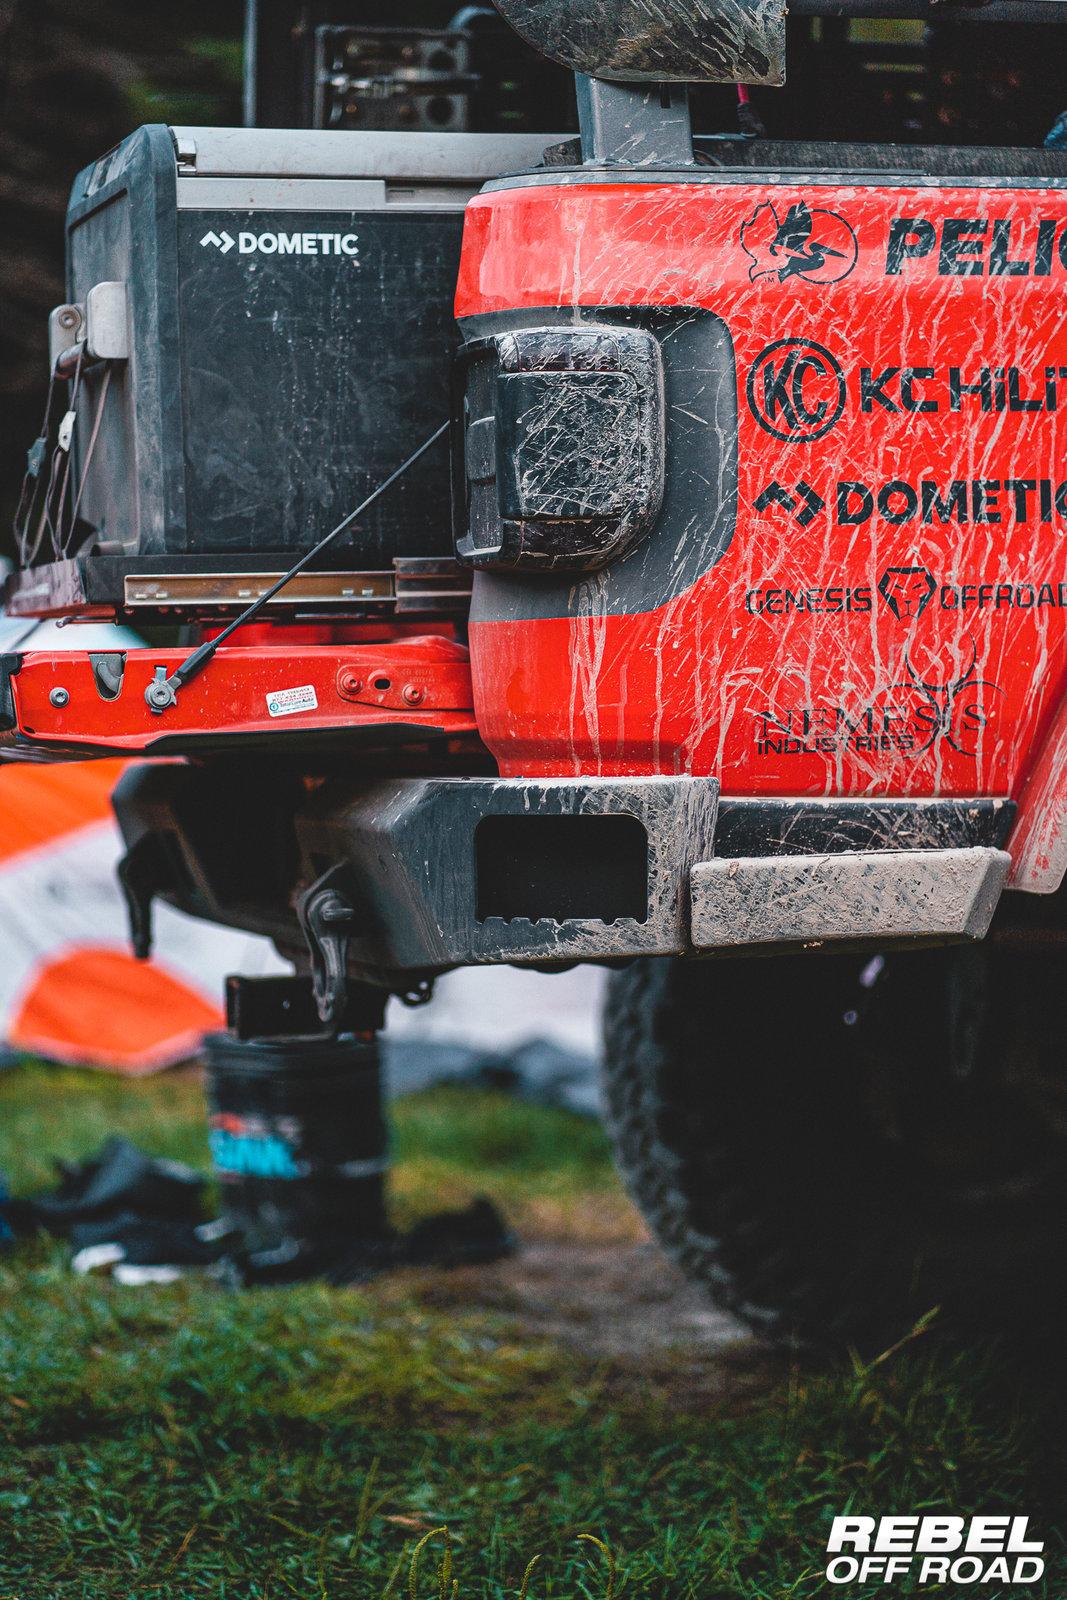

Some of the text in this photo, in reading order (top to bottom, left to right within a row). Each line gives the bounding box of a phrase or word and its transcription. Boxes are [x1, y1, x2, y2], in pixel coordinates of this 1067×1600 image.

[238, 232, 359, 255] DOMETIC
[885, 218, 1067, 276] PELI
[763, 350, 828, 430] KC
[860, 367, 938, 413] KC
[746, 587, 873, 614] GENESIS
[757, 734, 914, 755] INDUSTRIES
